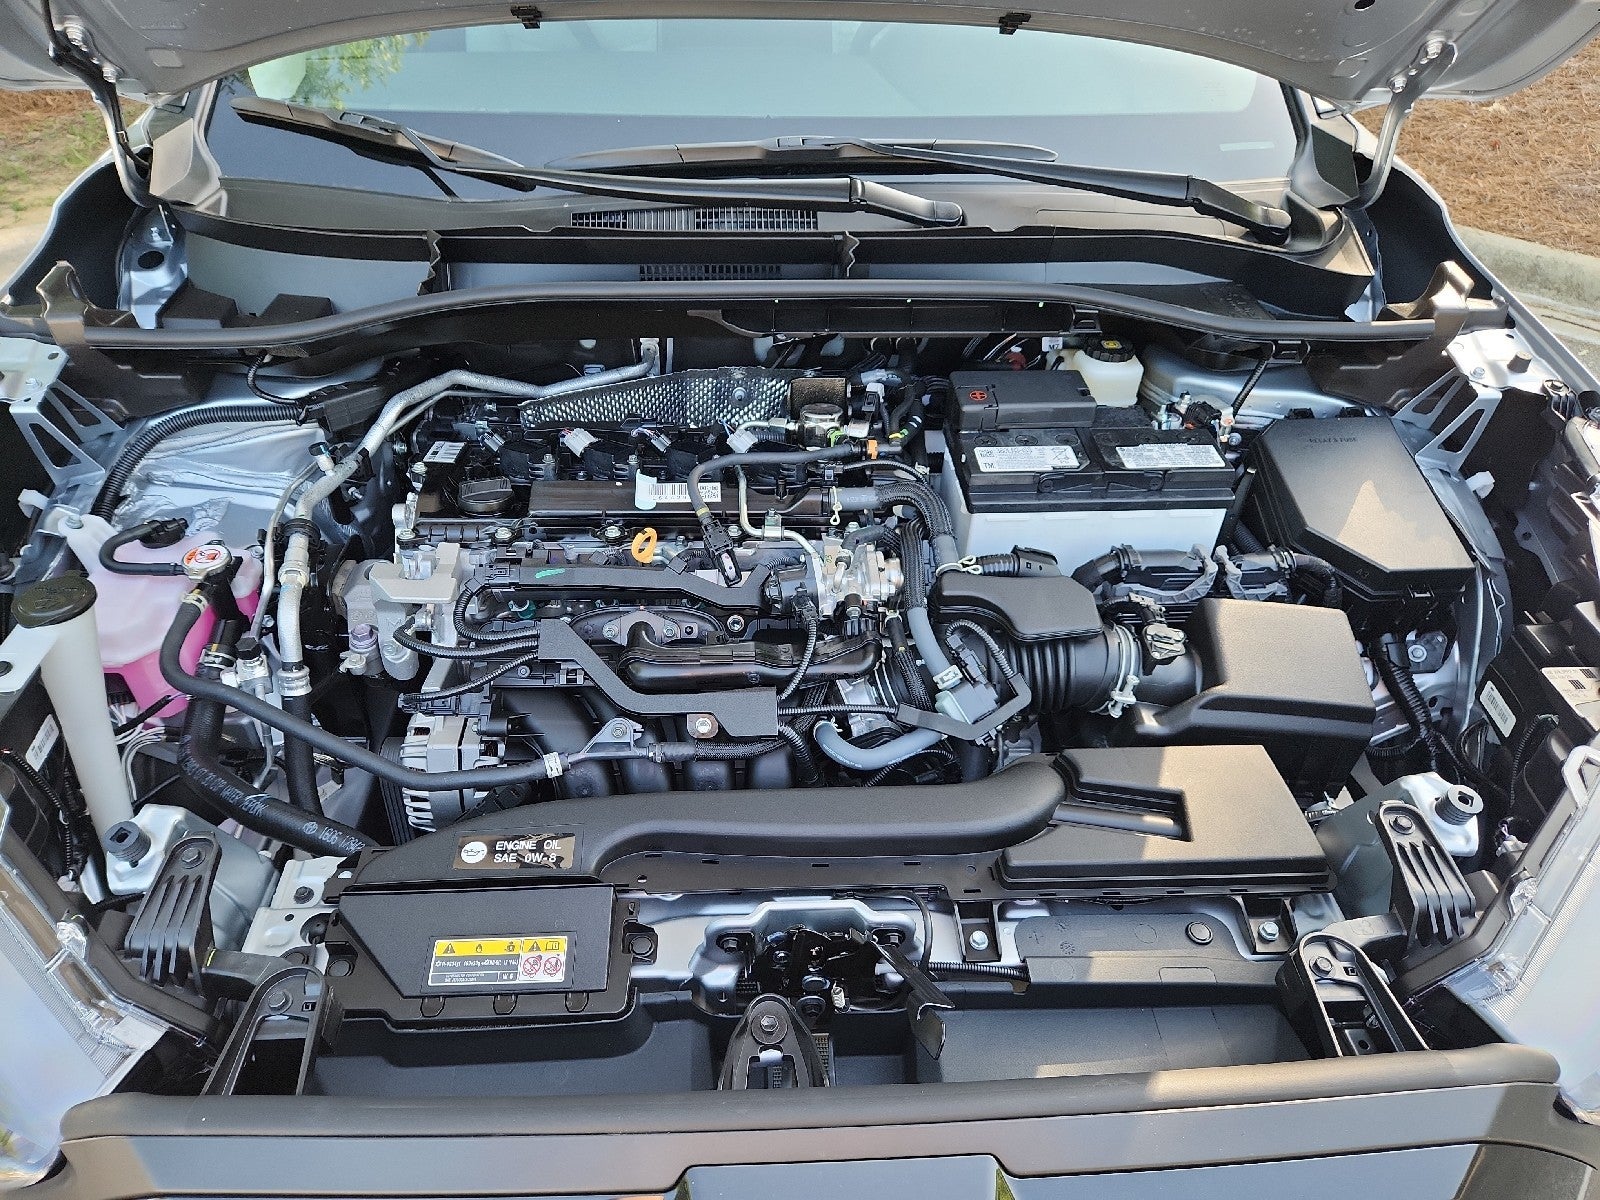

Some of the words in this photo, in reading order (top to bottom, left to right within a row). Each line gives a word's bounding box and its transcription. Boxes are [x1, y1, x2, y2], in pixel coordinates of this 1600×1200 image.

[495, 840, 537, 851] ENGINE
[543, 839, 562, 850] OIL
[493, 853, 518, 863] SAE
[524, 853, 557, 863] 0W-8
